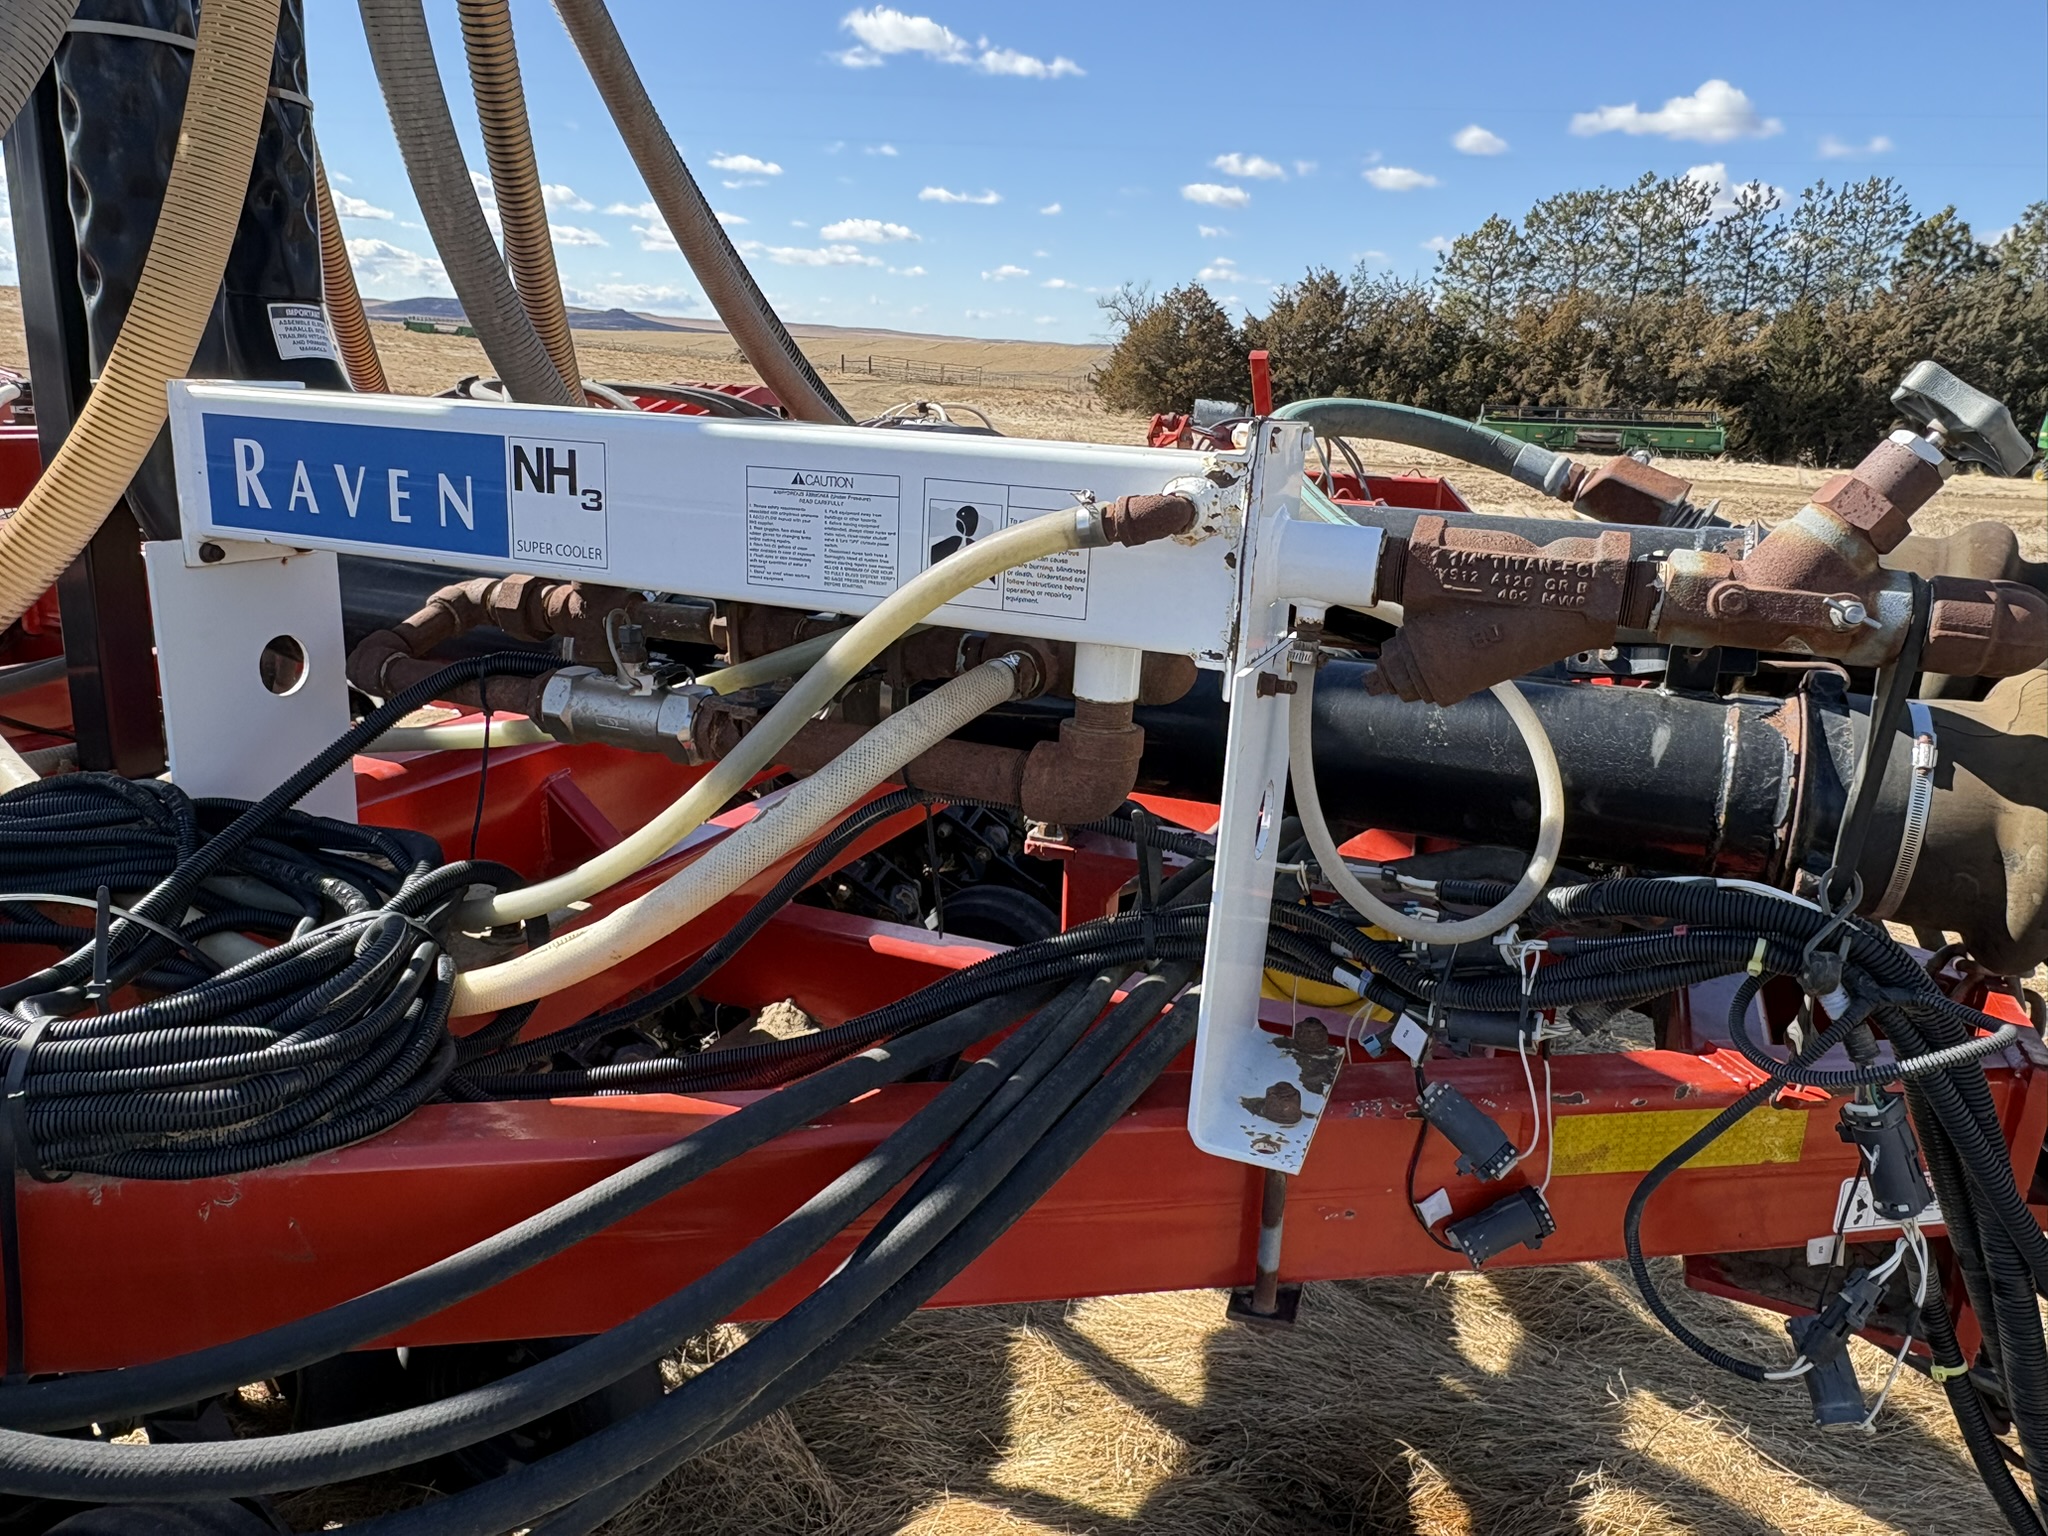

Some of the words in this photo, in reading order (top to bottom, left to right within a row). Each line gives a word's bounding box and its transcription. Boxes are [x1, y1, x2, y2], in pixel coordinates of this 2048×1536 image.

[233, 438, 474, 531] RAVEN
[805, 474, 854, 489] CAUTION
[517, 539, 553, 555] SUPER
[555, 544, 602, 560] COOLER
[1037, 573, 1073, 582] Understand
[1544, 578, 1569, 591] GR
[1044, 592, 1072, 600] repairing
